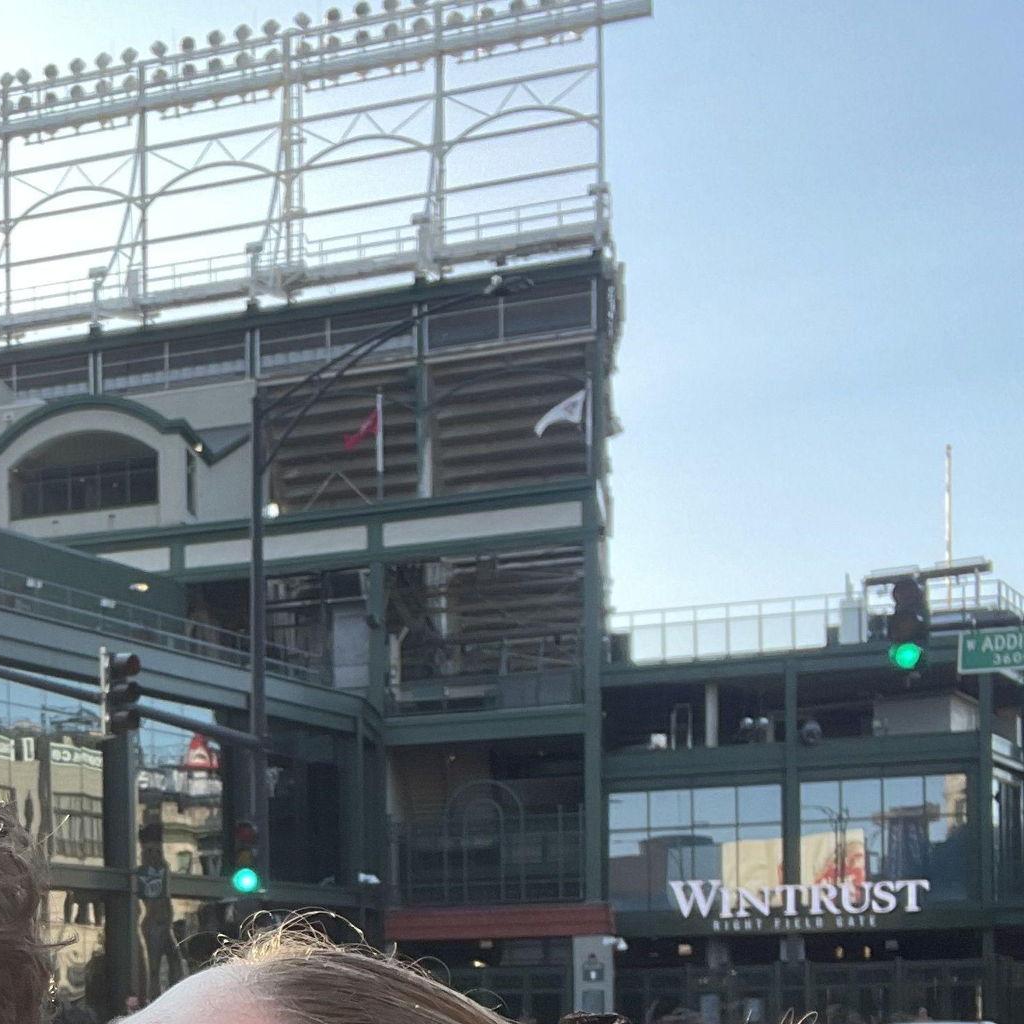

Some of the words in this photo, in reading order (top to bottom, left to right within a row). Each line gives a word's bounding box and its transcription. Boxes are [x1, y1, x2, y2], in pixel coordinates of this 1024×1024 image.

[669, 879, 930, 919] WINTRUST
[712, 918, 763, 932] RIGHT
[775, 916, 824, 930] FIELD
[836, 914, 877, 929] GATE
